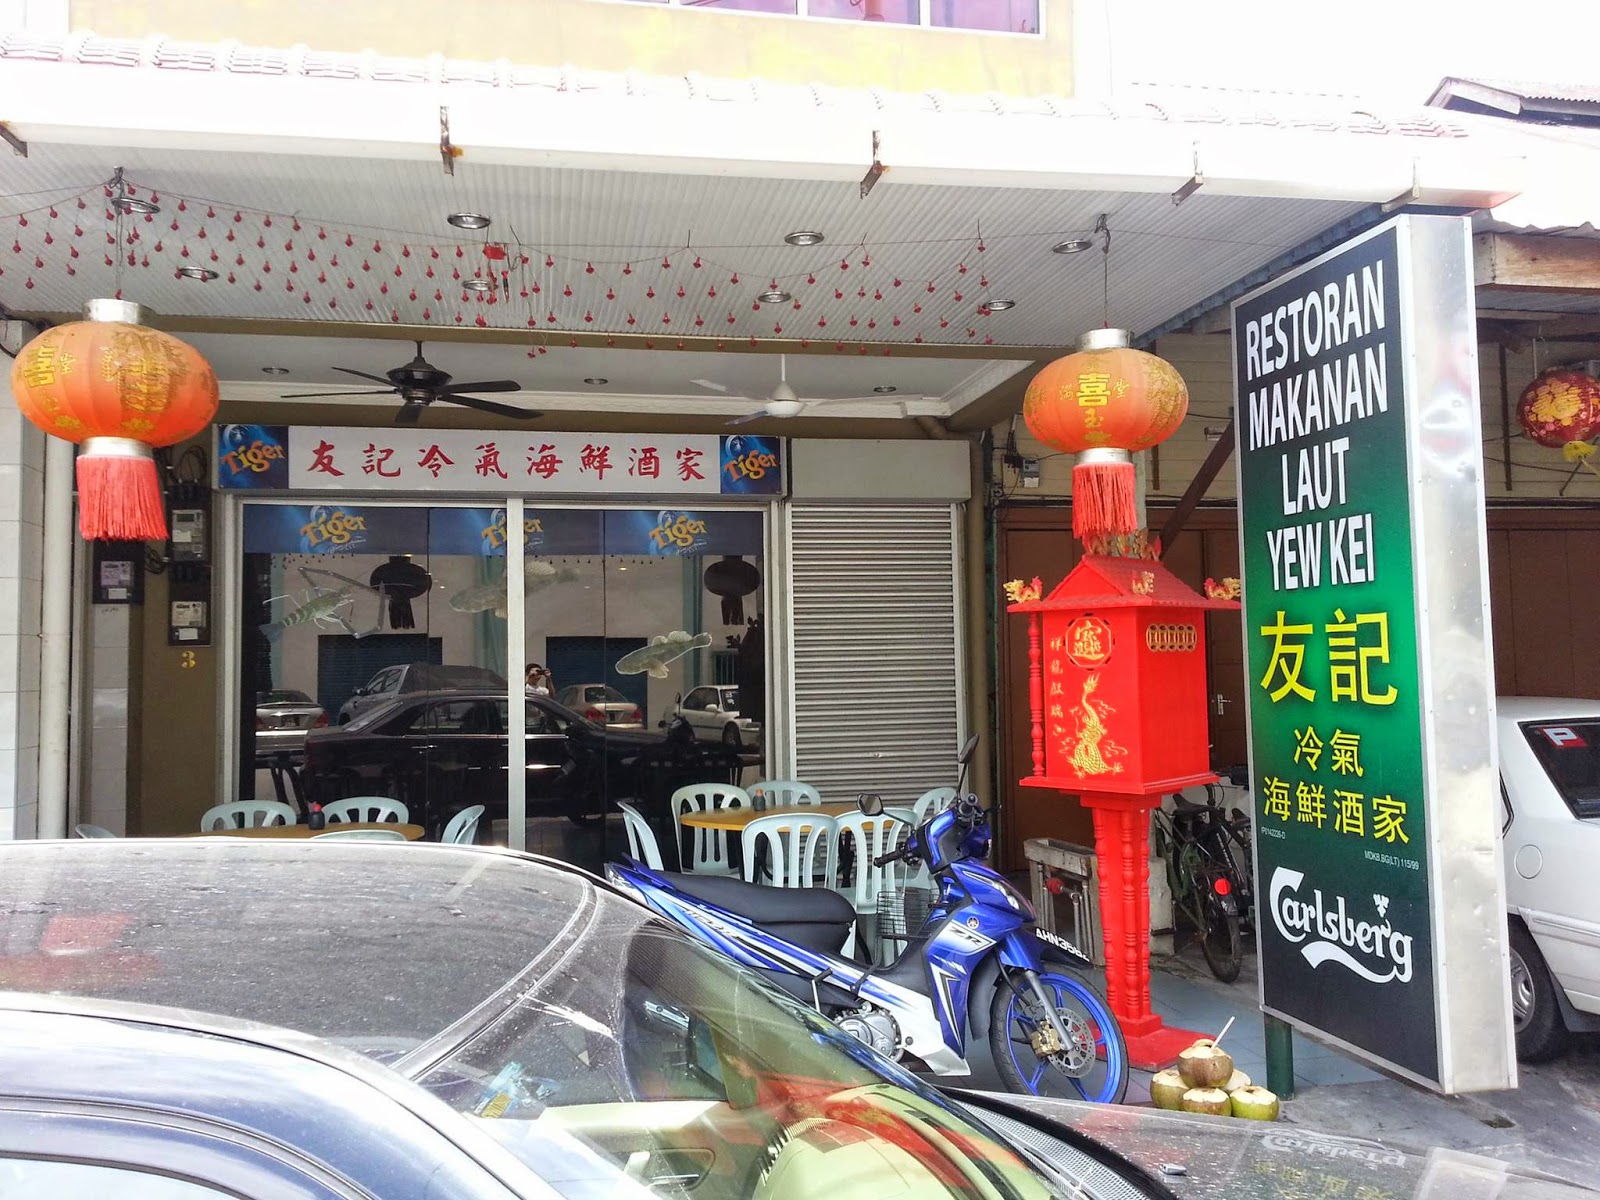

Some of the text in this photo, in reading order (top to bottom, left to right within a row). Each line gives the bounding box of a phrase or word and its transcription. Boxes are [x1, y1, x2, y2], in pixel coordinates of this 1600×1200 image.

[1246, 259, 1386, 382] RESTORAN
[1249, 342, 1388, 452] MAKANAN
[219, 440, 286, 475] Tiger
[306, 439, 706, 482] 友記冷氣海鮮酒家
[724, 449, 777, 482] Tiger
[1281, 437, 1350, 516] LAUT
[300, 511, 368, 547] Tiger
[648, 514, 707, 549] Tiger
[1266, 513, 1375, 591] YEW KEI
[181, 650, 197, 668] 3
[1260, 608, 1398, 705] 友記
[1293, 725, 1364, 778] 冷氣
[1542, 727, 1578, 747] P
[1263, 776, 1410, 844] 海鮮酒家
[1270, 866, 1413, 983] Carlsberg
